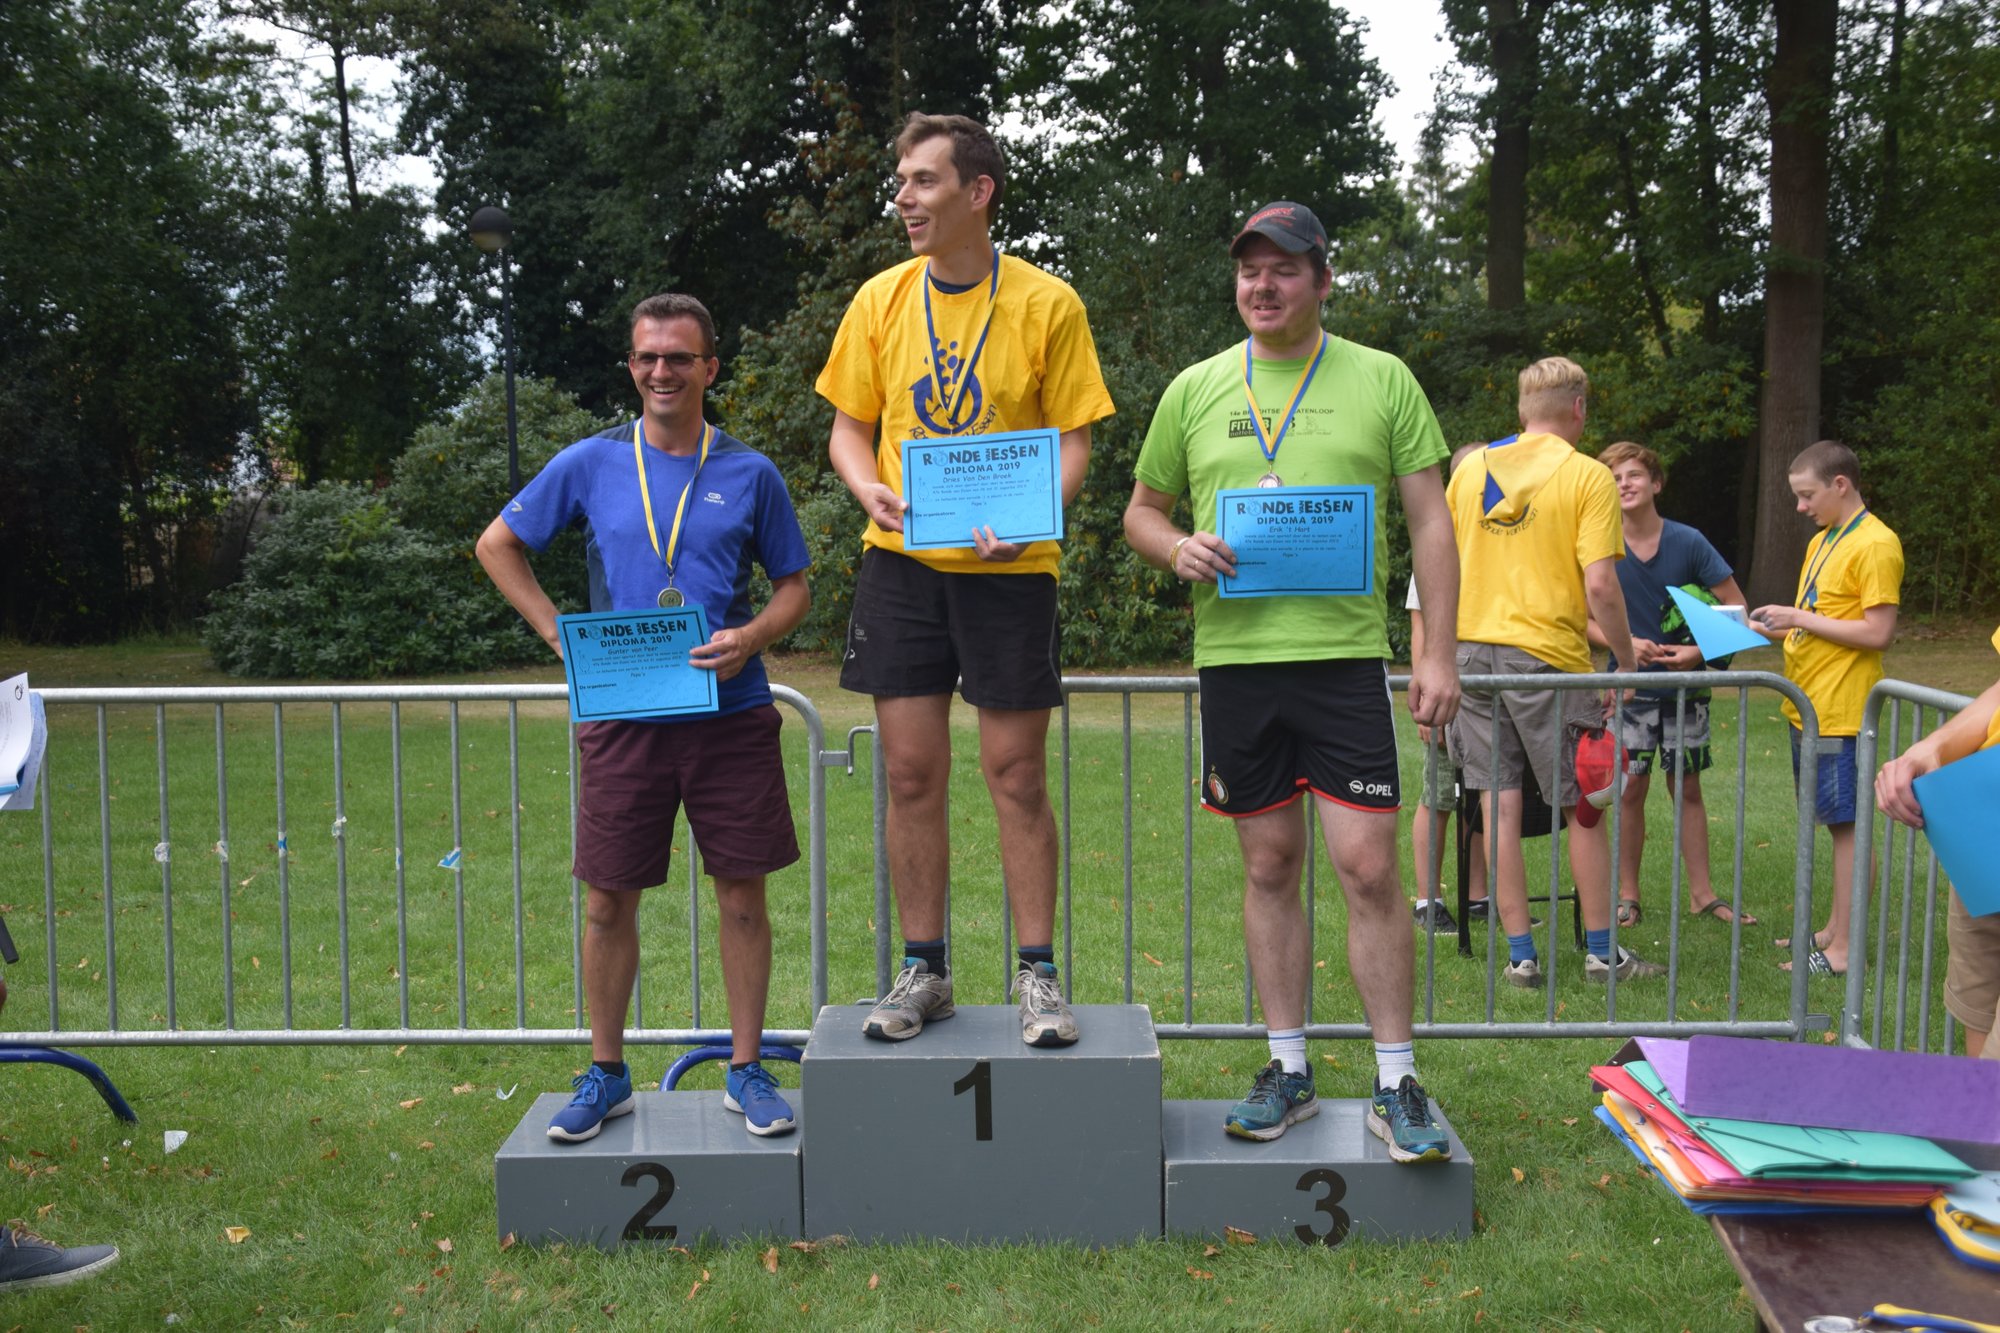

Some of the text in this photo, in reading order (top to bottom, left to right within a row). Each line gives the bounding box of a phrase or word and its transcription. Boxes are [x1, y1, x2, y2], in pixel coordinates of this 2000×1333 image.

[991, 444, 1040, 461] ESSEN
[944, 461, 1021, 475] DIPLOMA 2019
[1304, 498, 1353, 514] ESSEN
[1257, 515, 1334, 525] DIPLOMA 2019
[641, 619, 688, 635] ESSEN
[600, 634, 672, 648] DIPLOMA 2019
[1365, 783, 1393, 797] OPEL
[953, 1061, 993, 1141] 1
[620, 1162, 677, 1241] 2
[1294, 1168, 1350, 1247] 3
